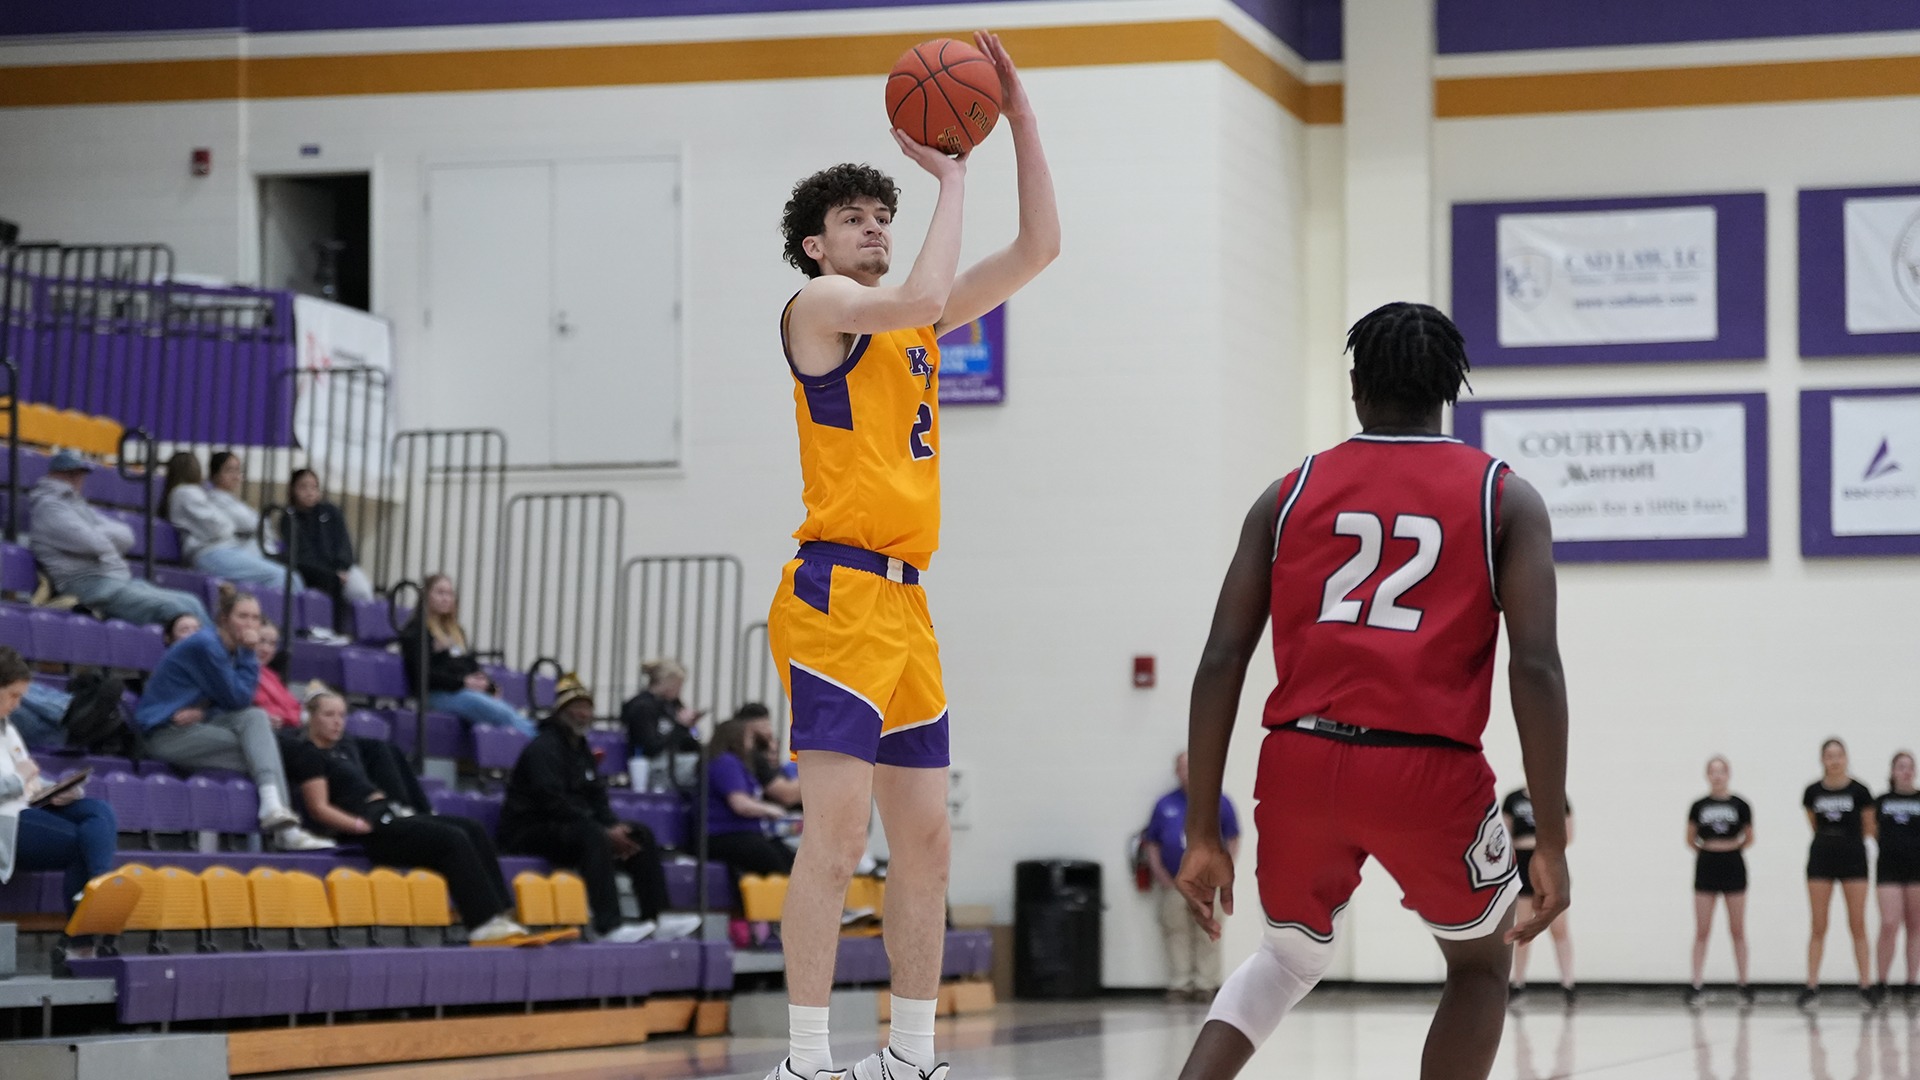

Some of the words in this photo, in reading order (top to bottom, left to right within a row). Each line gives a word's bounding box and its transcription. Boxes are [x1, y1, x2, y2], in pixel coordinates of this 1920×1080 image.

[909, 401, 937, 461] 2
[1519, 427, 1704, 458] COURTYARD
[1559, 461, 1655, 487] Marriott
[1316, 510, 1444, 633] 22
